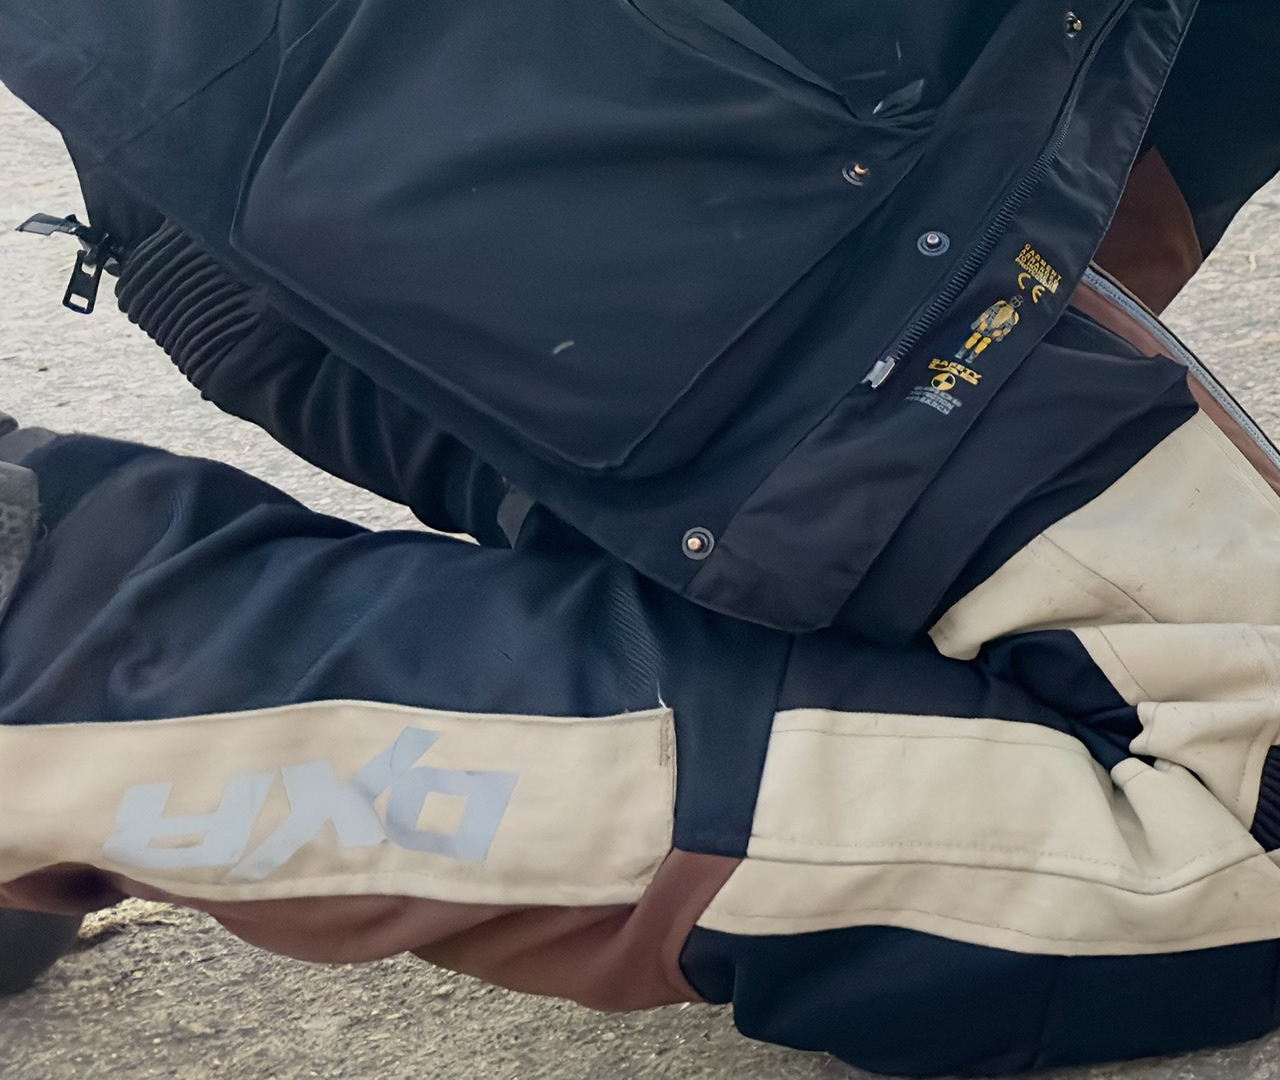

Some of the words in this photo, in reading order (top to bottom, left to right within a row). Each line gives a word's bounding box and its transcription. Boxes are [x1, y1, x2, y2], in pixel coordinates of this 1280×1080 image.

[1024, 242, 1062, 280] GARMENT
[1018, 271, 1045, 302] CE
[931, 357, 982, 378] SAFETY
